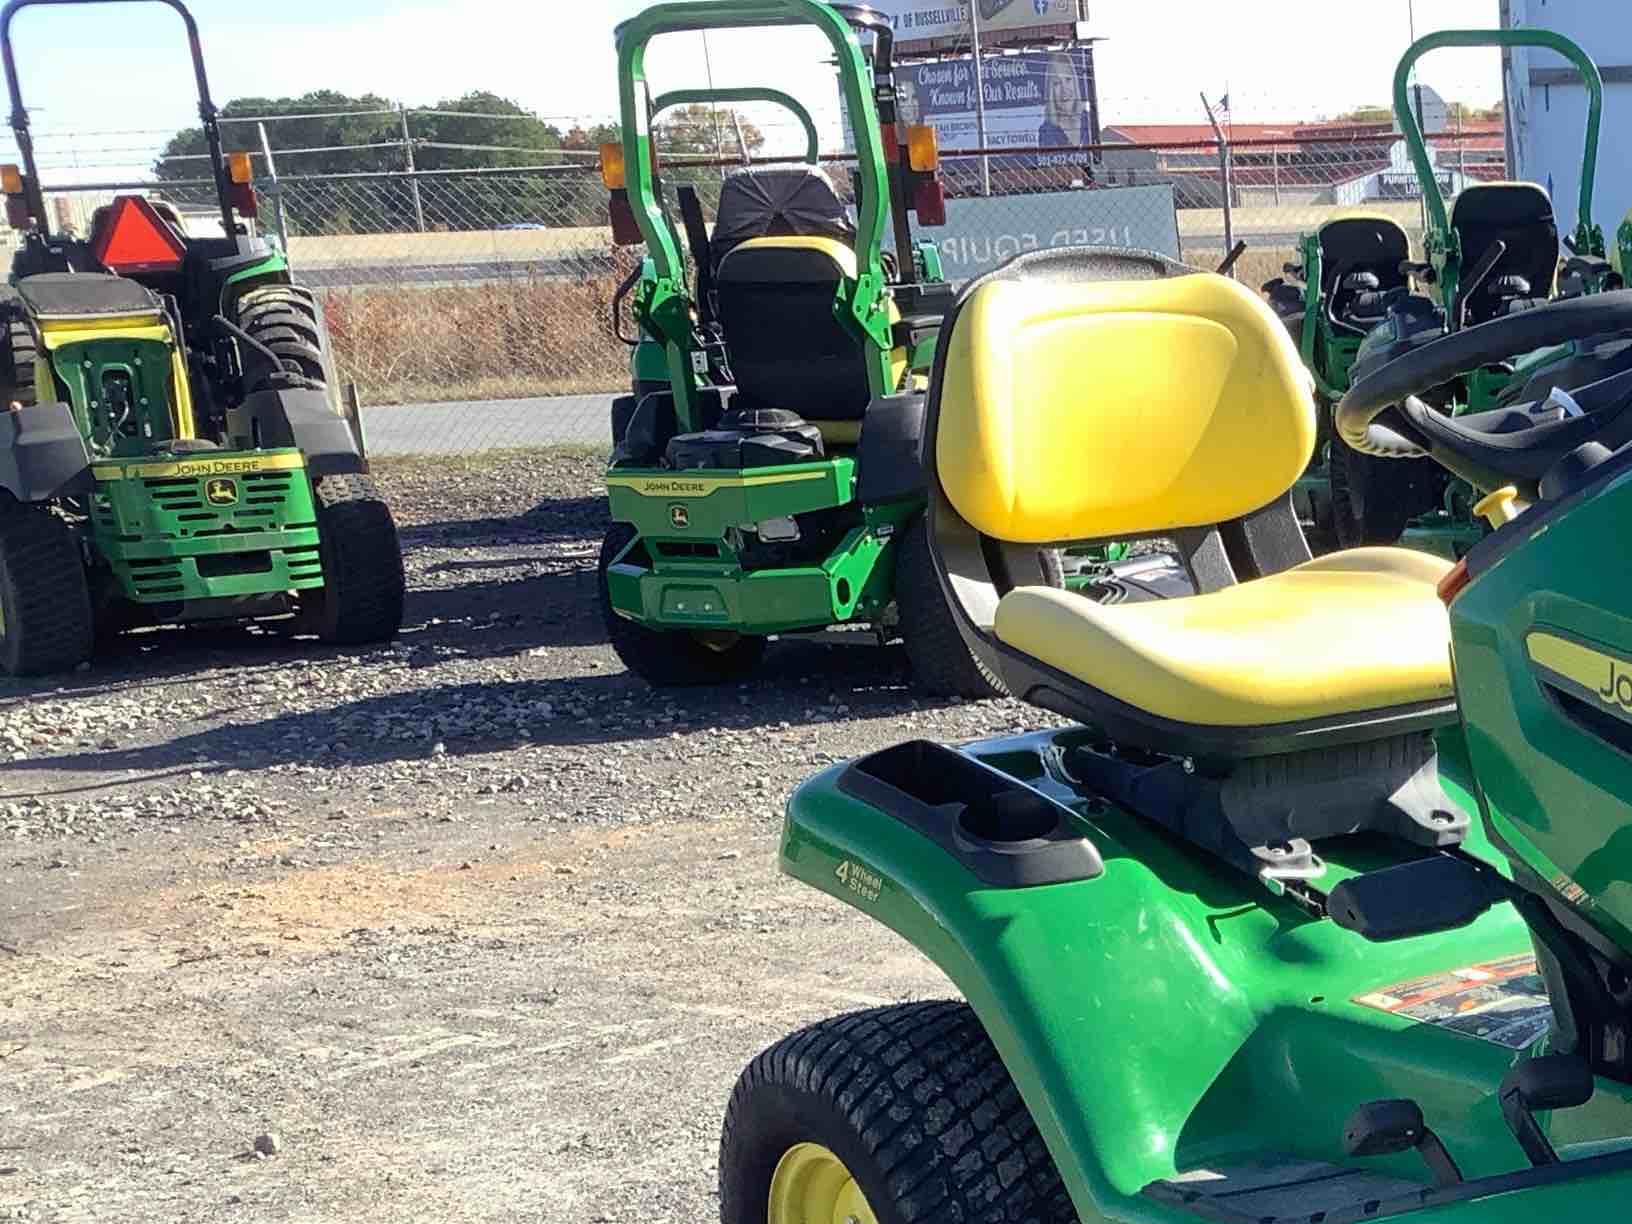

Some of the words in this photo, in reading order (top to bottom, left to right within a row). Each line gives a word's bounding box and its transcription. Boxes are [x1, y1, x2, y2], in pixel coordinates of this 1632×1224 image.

[174, 463, 211, 476] JOHN
[215, 460, 260, 474] DEERE
[643, 481, 670, 492] JOHN
[672, 480, 705, 492] DEERE
[835, 860, 849, 883] 4
